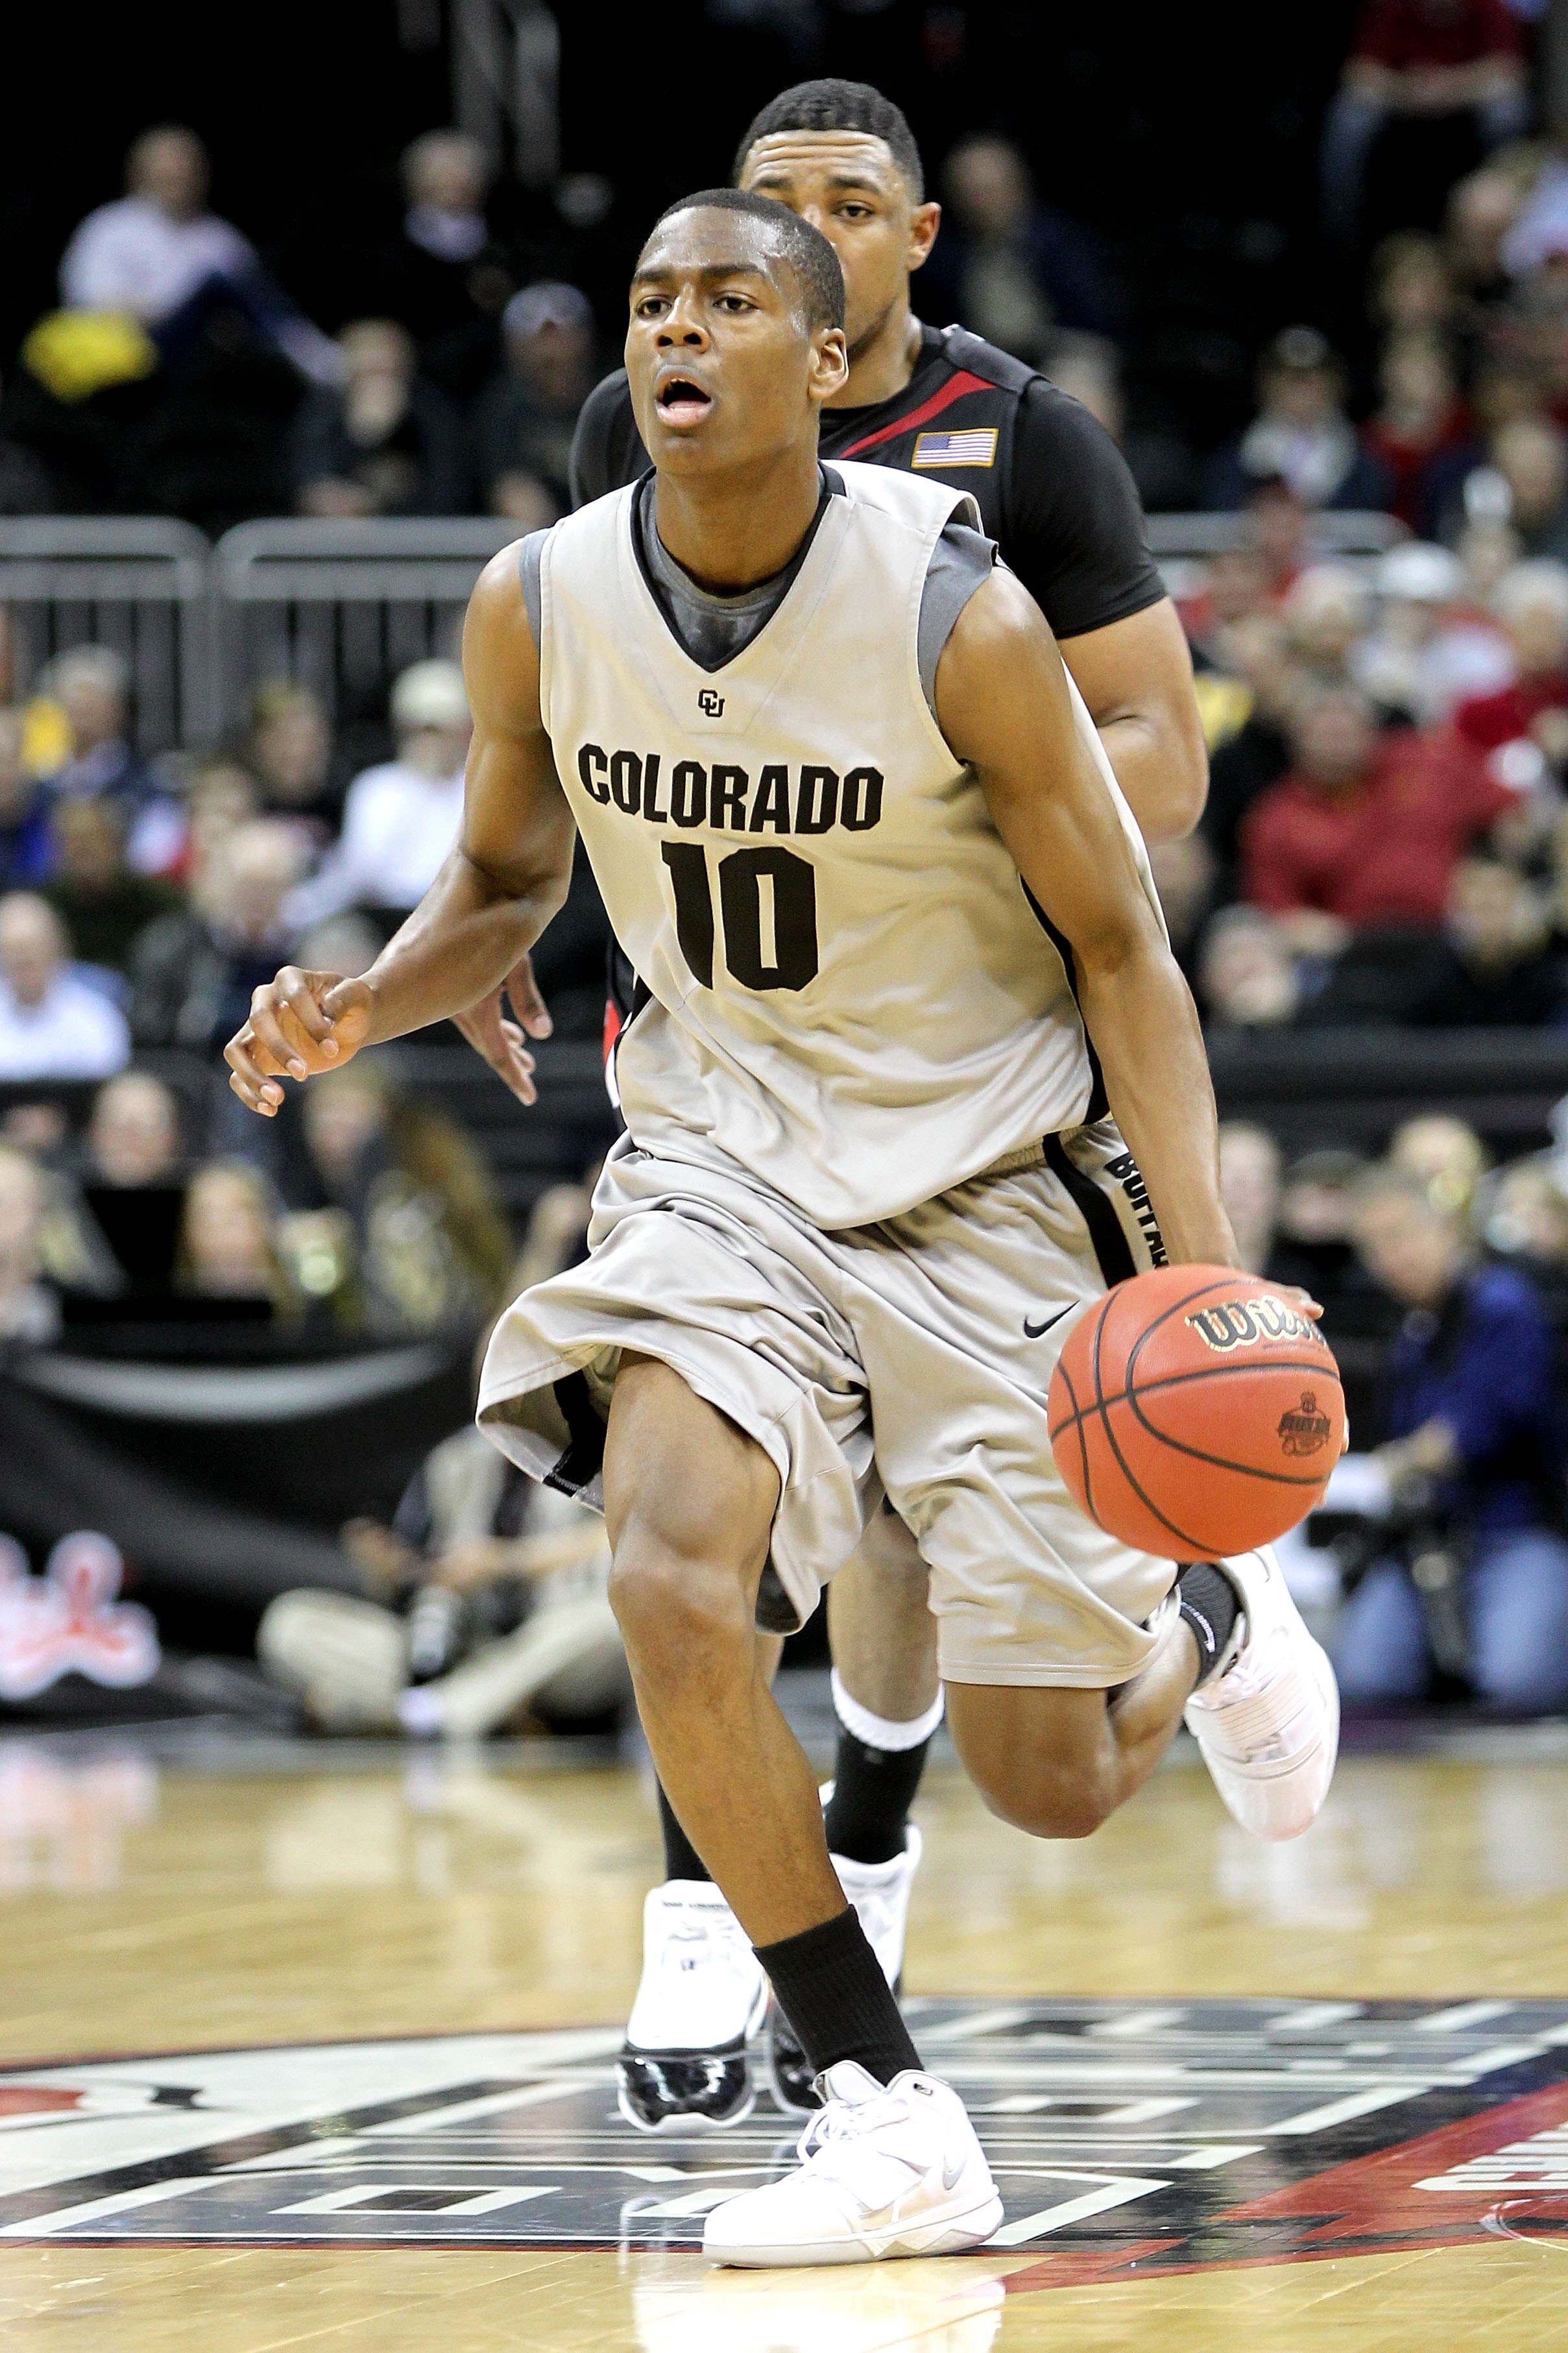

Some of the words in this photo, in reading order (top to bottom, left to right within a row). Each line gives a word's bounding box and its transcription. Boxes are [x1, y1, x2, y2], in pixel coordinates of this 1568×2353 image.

[577, 743, 885, 835] COLORADO
[660, 840, 819, 992] 10
[1104, 1152, 1170, 1270] BUFFAL
